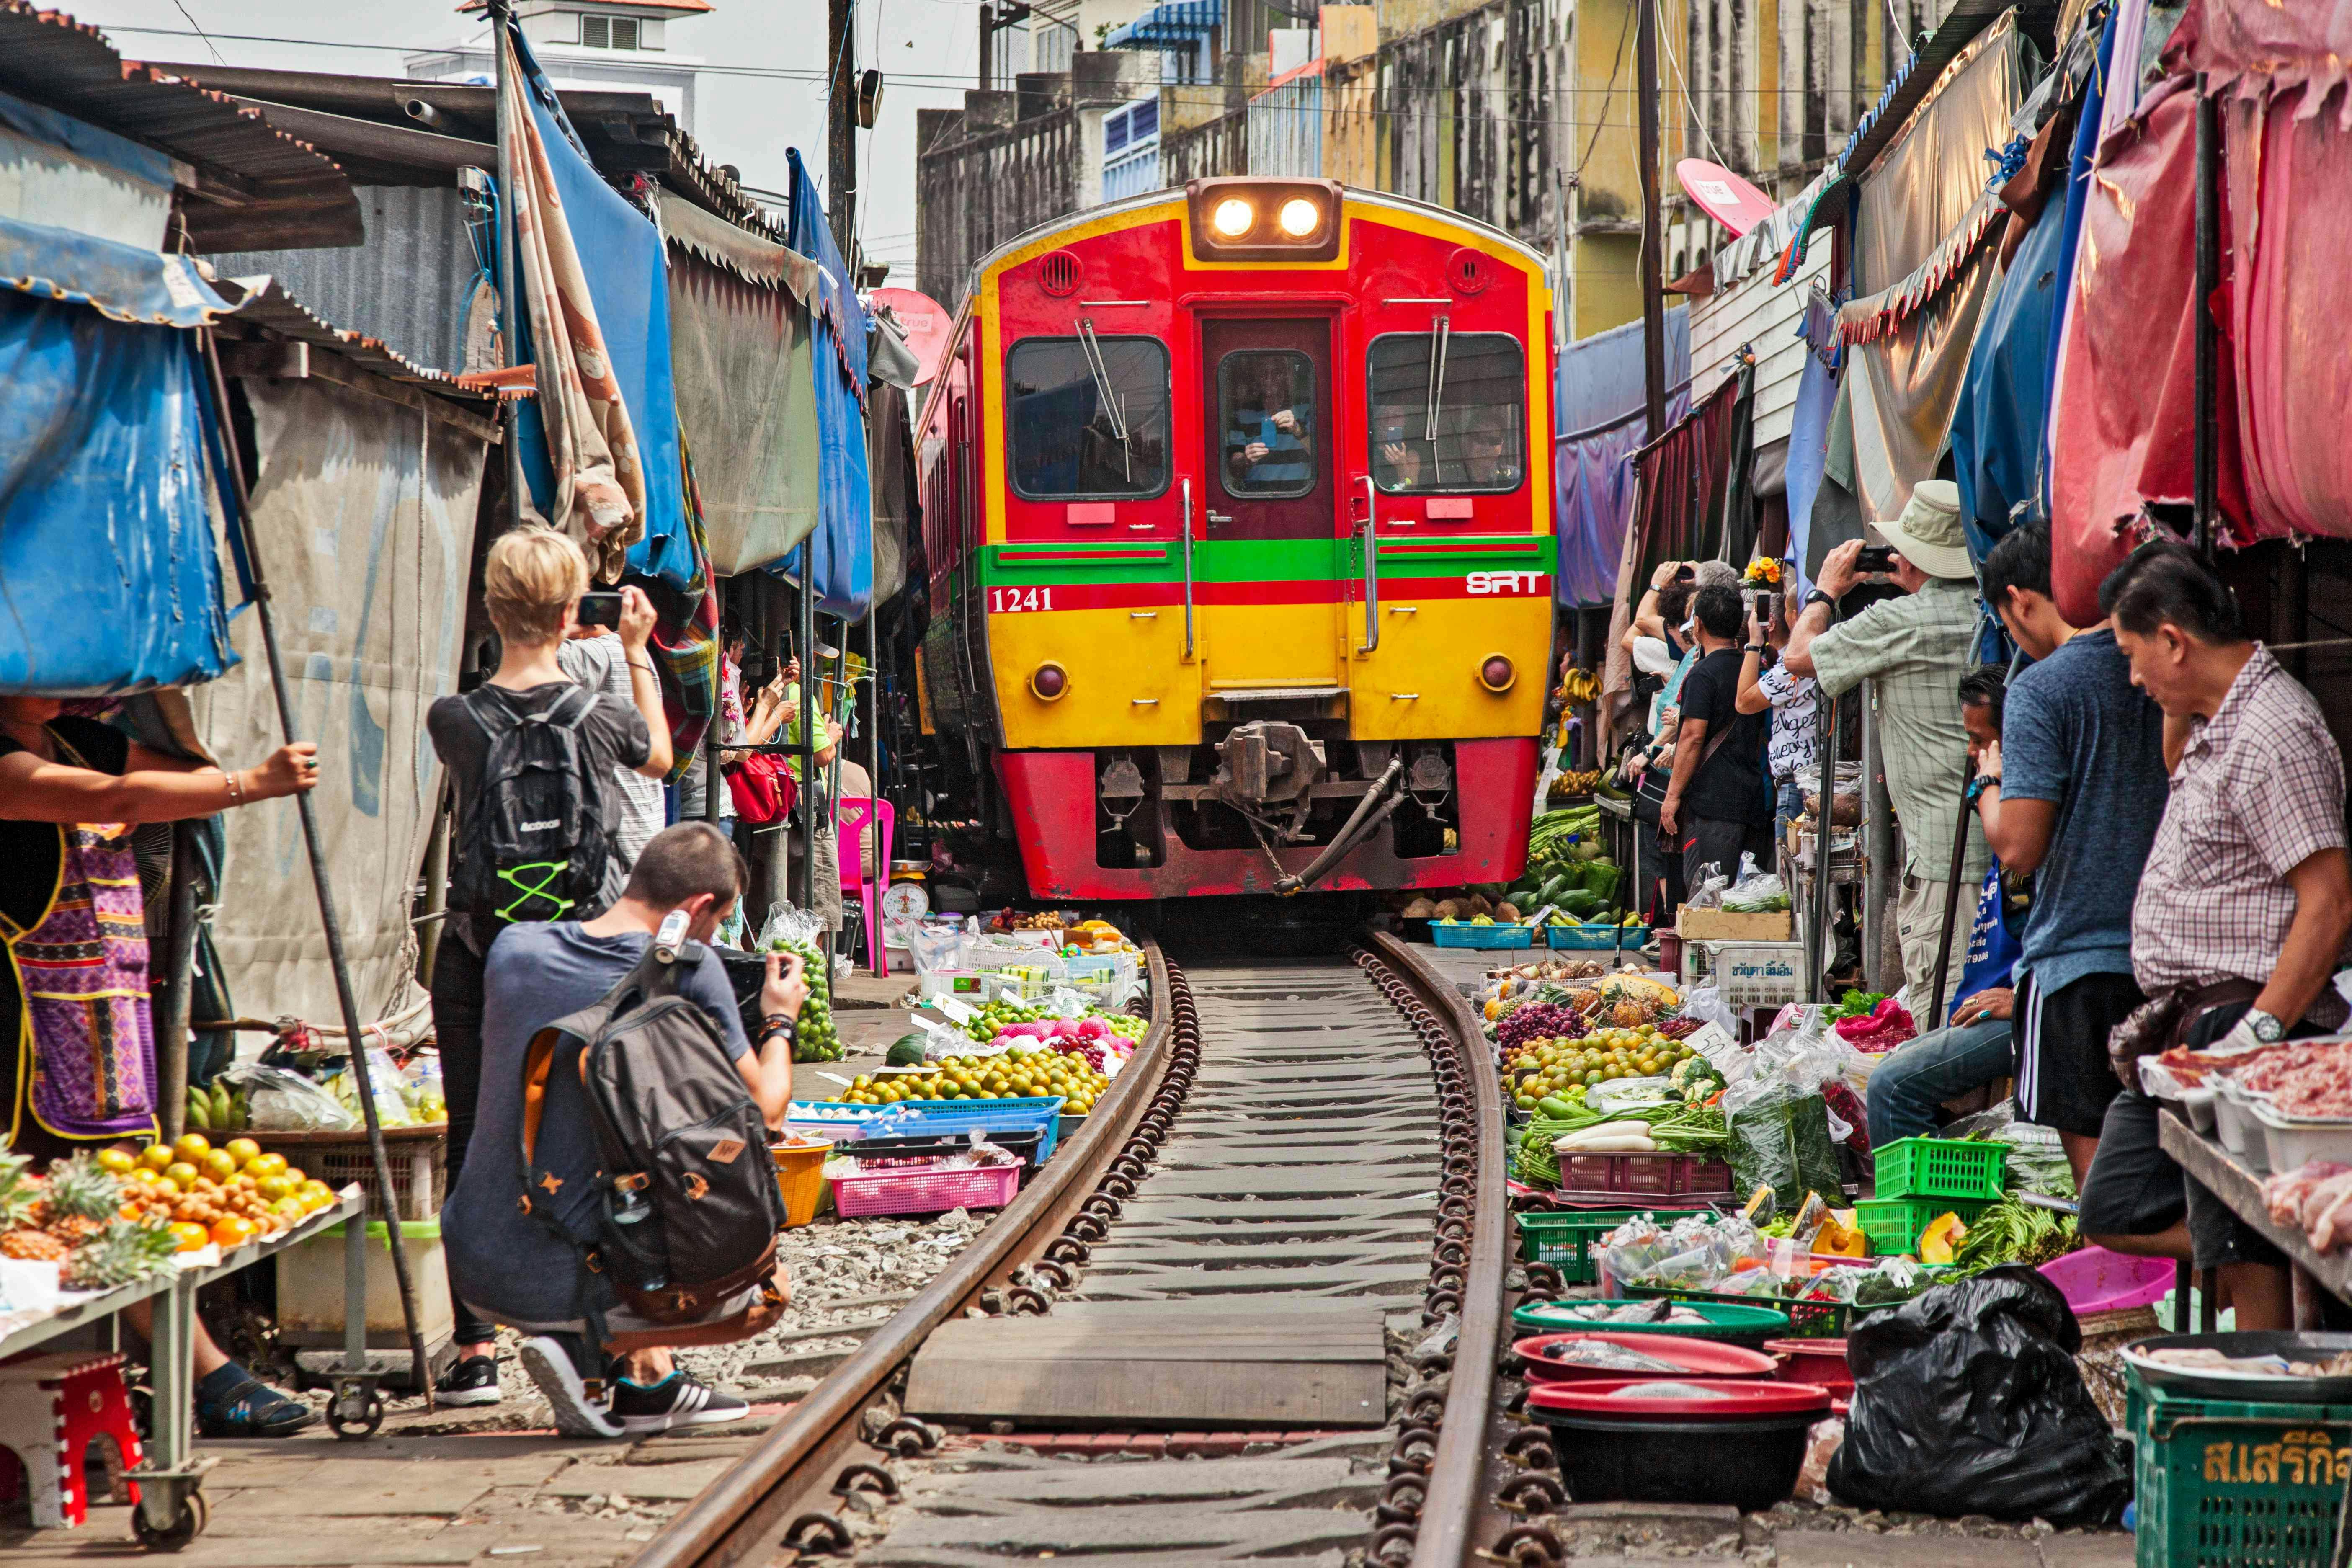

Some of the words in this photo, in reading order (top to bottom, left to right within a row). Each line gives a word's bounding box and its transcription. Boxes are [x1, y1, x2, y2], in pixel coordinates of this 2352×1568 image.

[1700, 183, 1724, 194] true
[901, 316, 928, 327] true
[1466, 570, 1545, 593] SRT
[992, 587, 1054, 612] 1241
